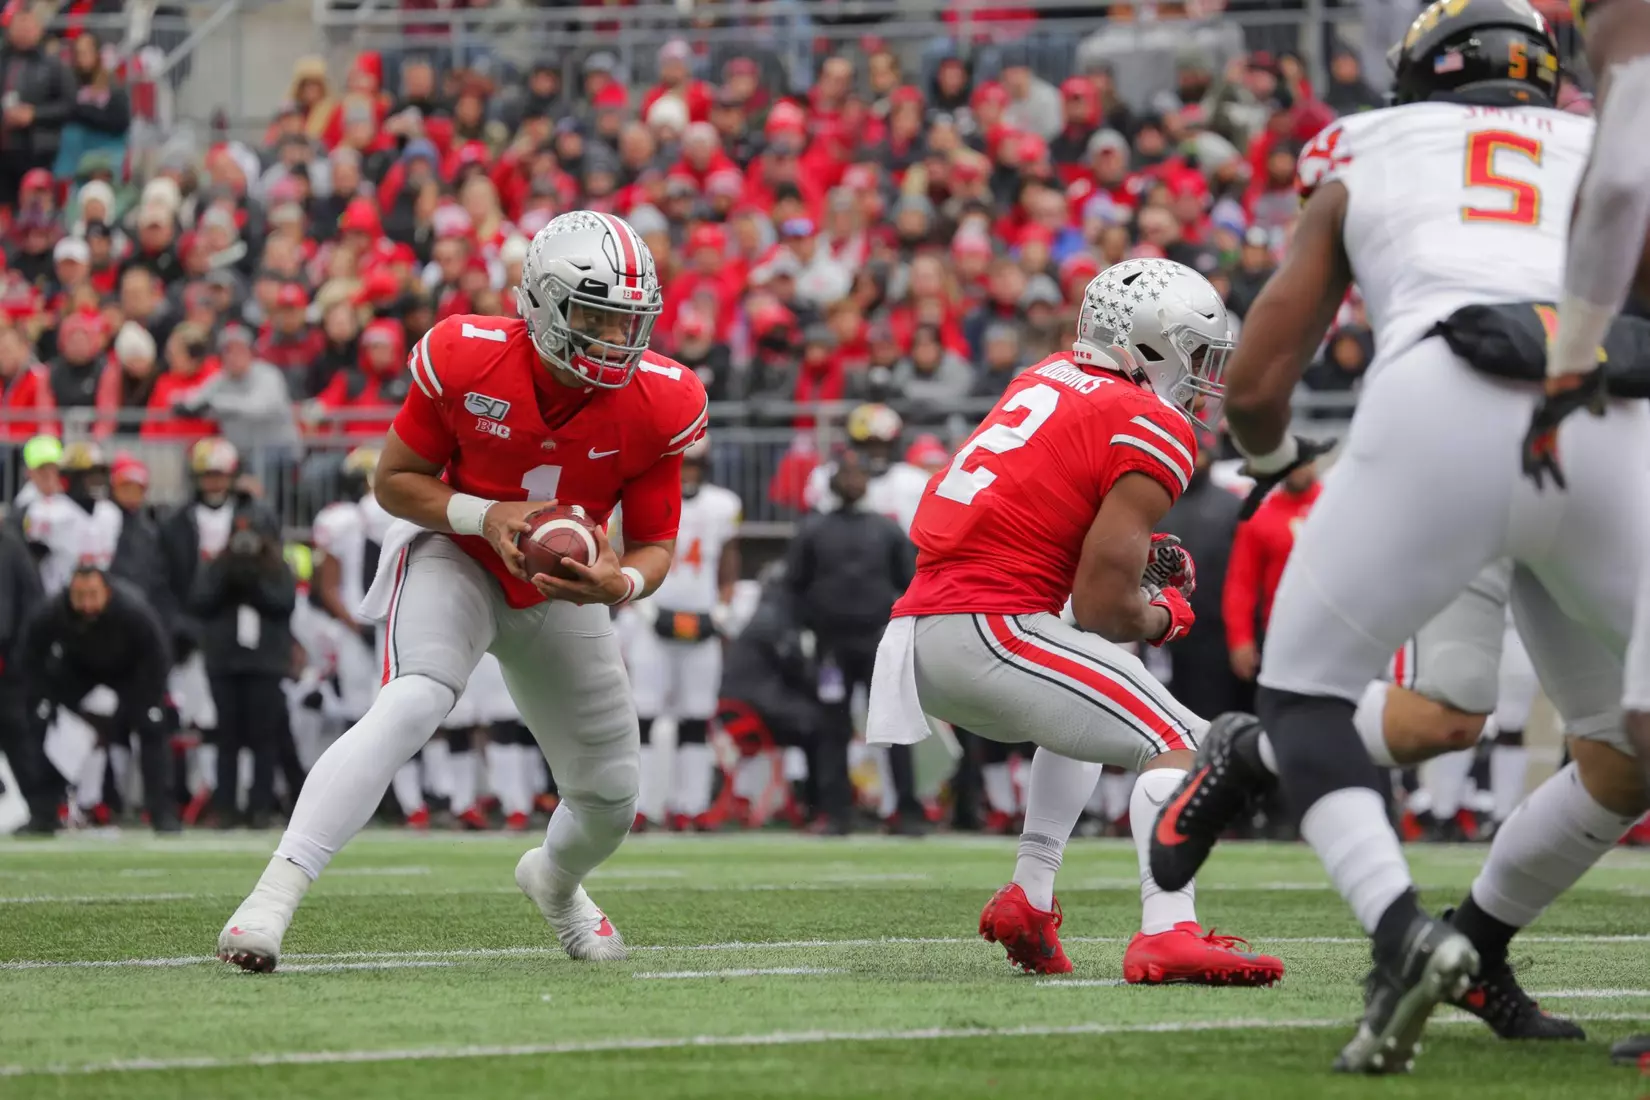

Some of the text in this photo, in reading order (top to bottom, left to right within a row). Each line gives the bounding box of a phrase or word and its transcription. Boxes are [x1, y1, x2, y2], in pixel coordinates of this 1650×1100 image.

[1508, 43, 1527, 79] 5
[1461, 129, 1541, 225] 5
[462, 323, 507, 342] 1
[638, 360, 682, 381] 1
[464, 392, 511, 421] 150
[935, 383, 1060, 506] 2
[520, 464, 562, 502] 1
